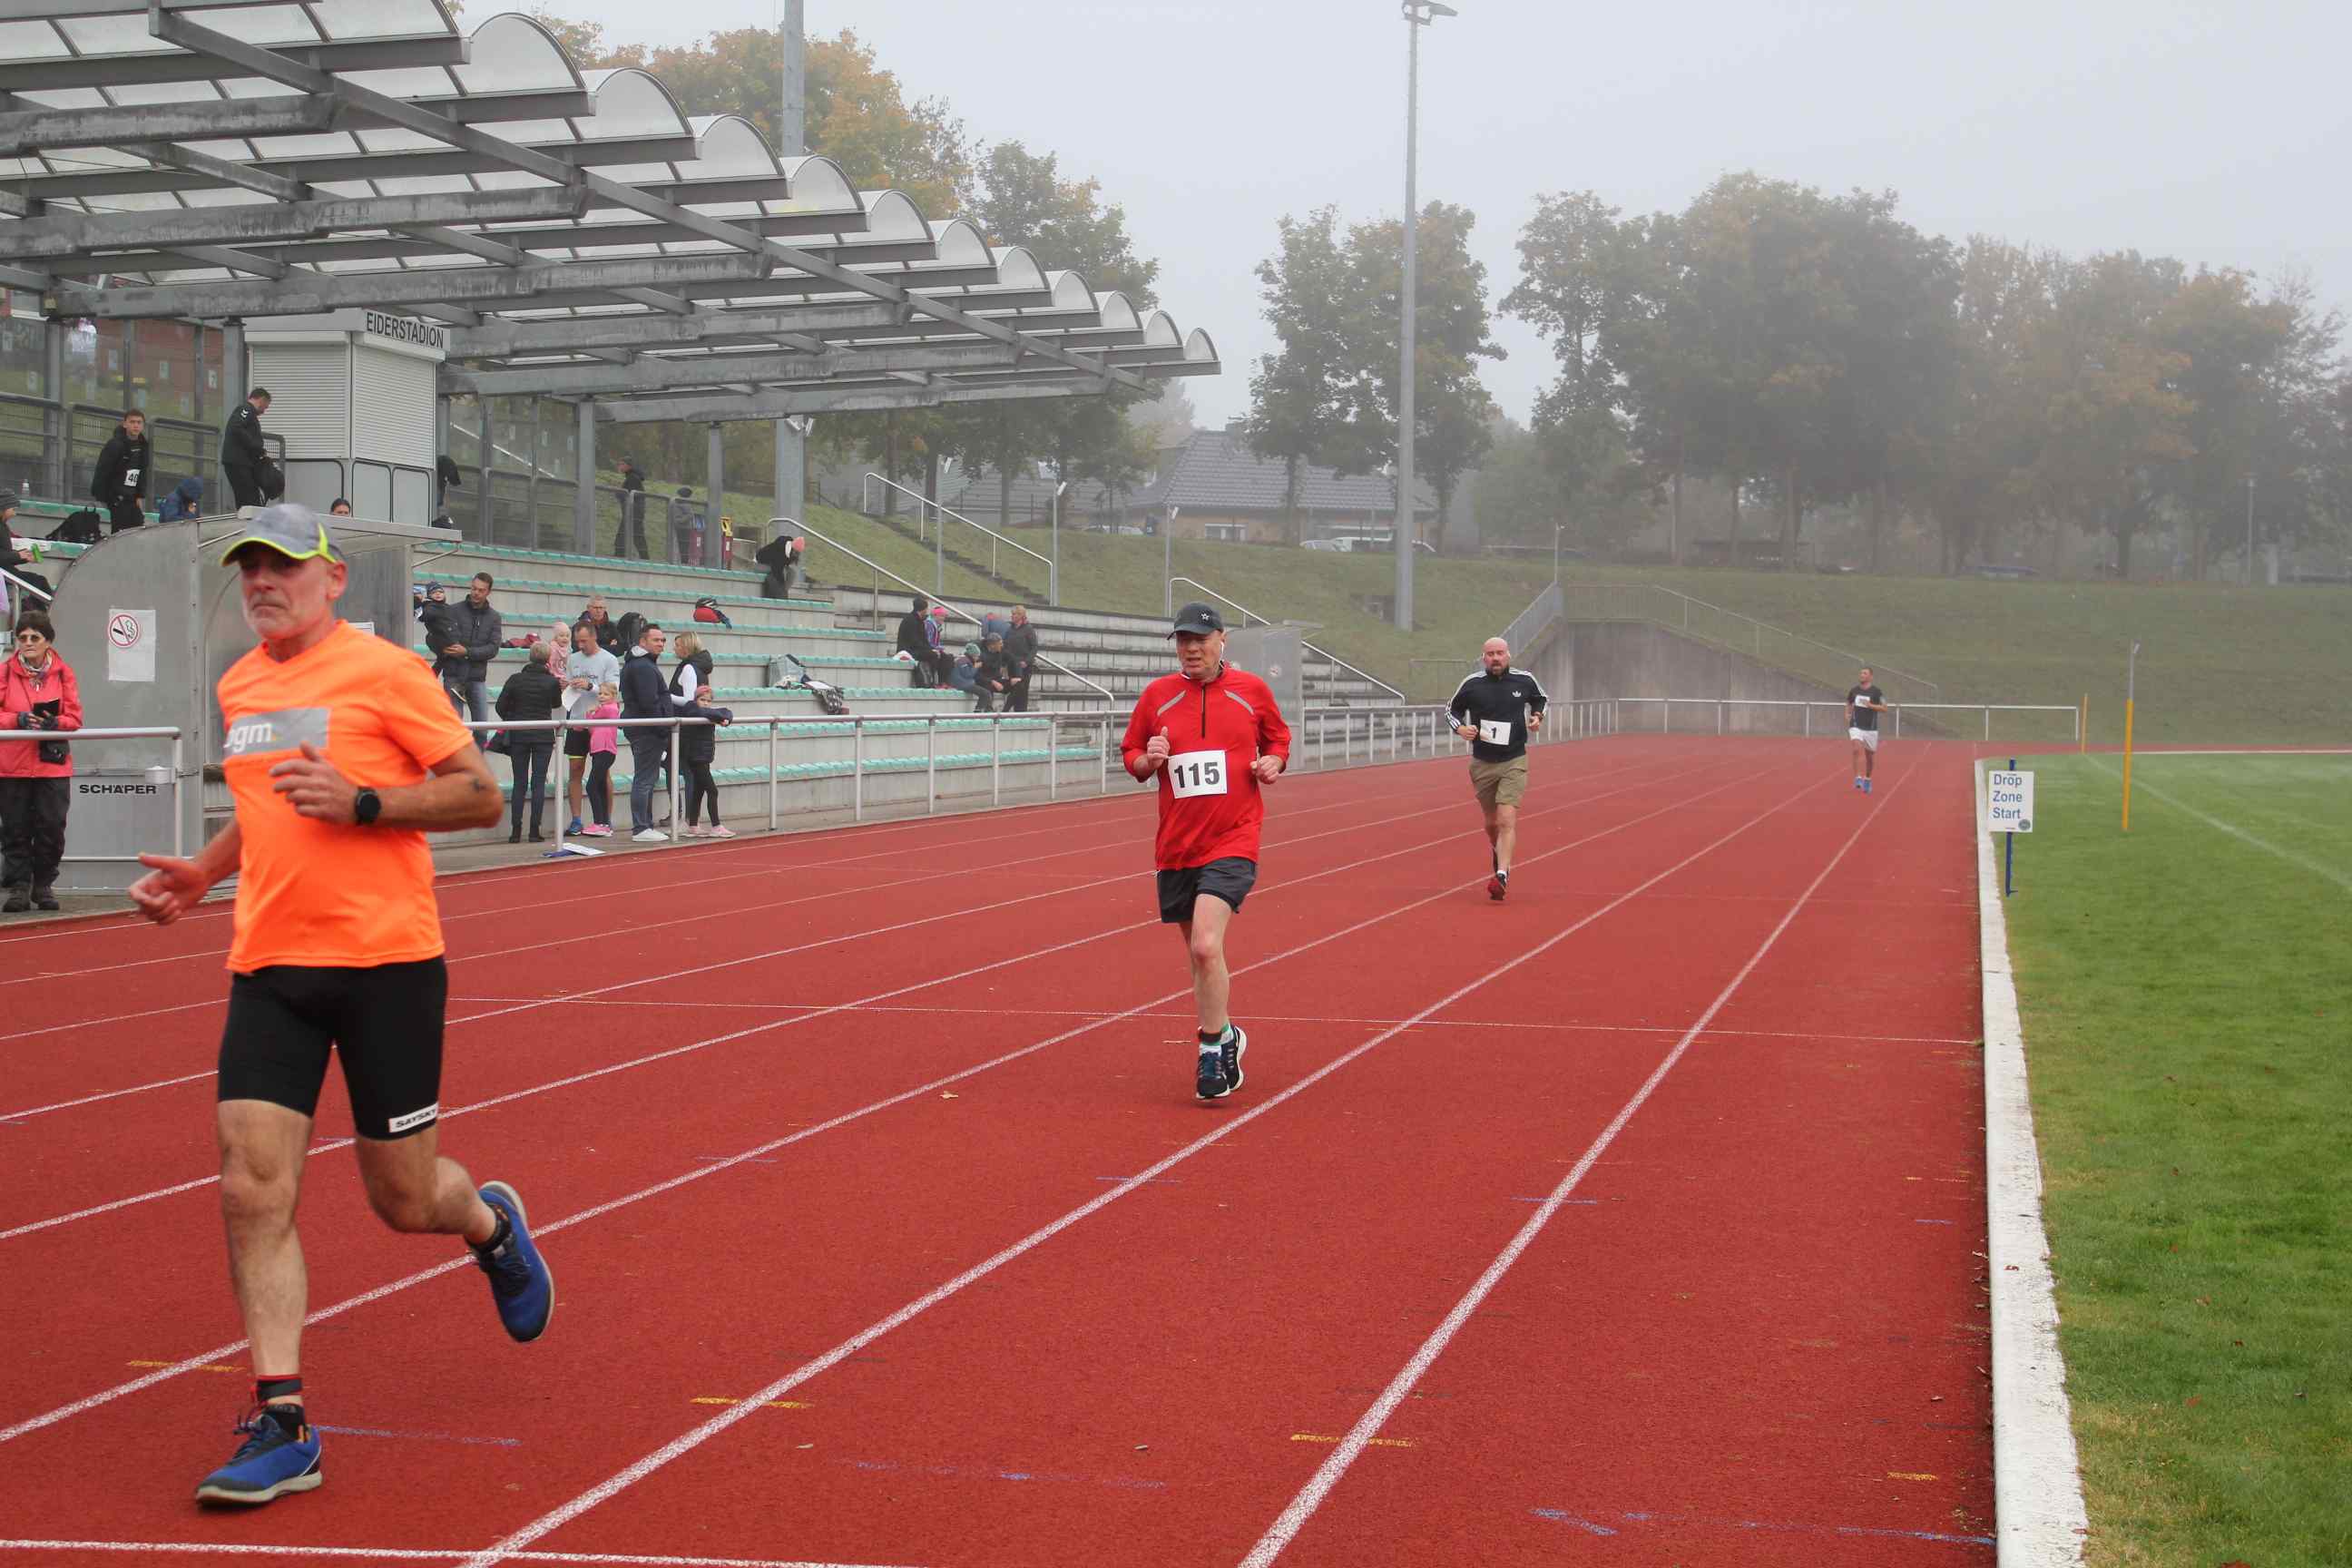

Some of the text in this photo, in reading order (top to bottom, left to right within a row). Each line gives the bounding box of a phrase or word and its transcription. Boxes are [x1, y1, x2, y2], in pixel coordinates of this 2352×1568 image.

[367, 311, 445, 348] EIDERSTADION
[1174, 762, 1220, 789] 115
[1994, 774, 2023, 788] Drop
[79, 784, 157, 794] SCHÄPER
[1993, 790, 2023, 802] Zone
[1993, 807, 2021, 818] Start
